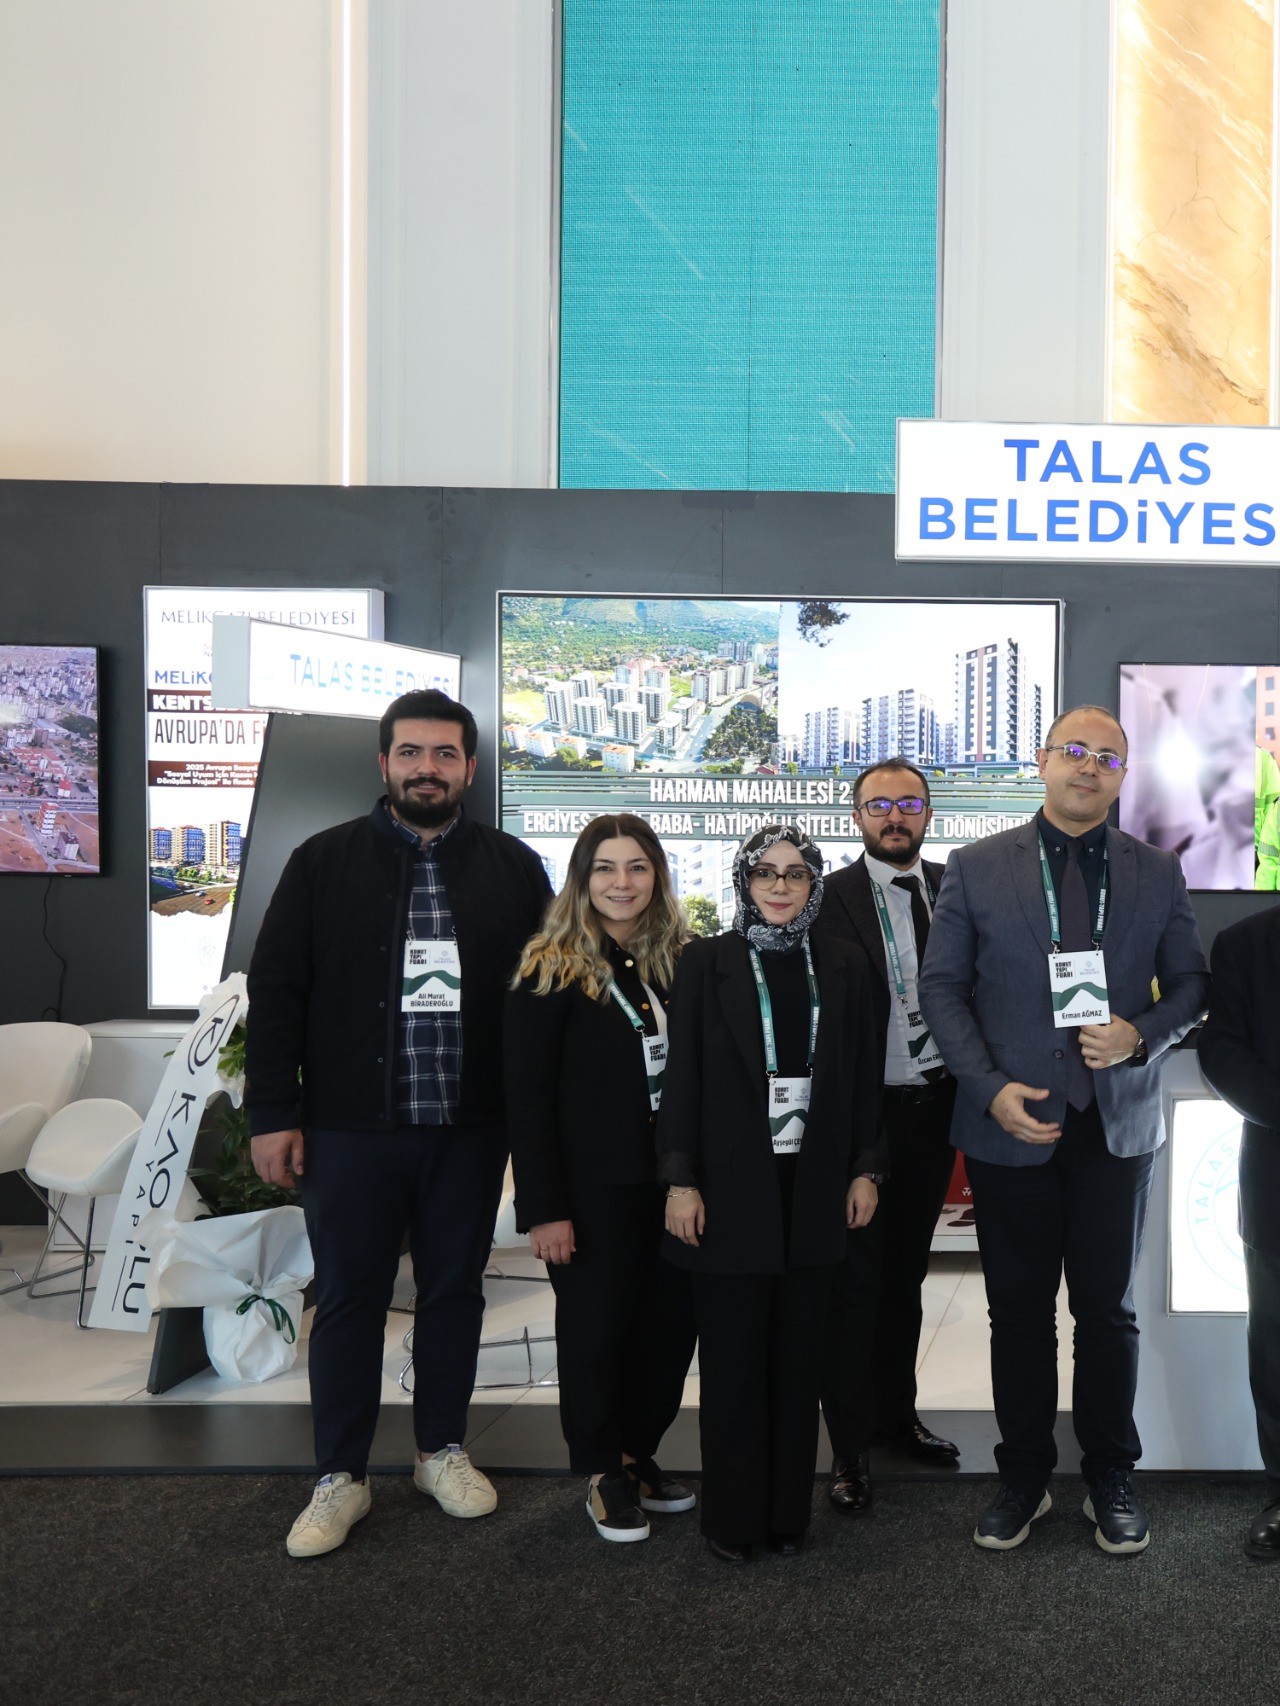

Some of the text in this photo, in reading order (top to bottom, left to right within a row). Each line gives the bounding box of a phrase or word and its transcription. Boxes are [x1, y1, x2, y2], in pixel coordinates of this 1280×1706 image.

[1004, 439, 1211, 486] TALAS
[290, 653, 353, 692] TALAS
[650, 779, 728, 804] HARMAN
[732, 777, 834, 805] MAHALLESİ
